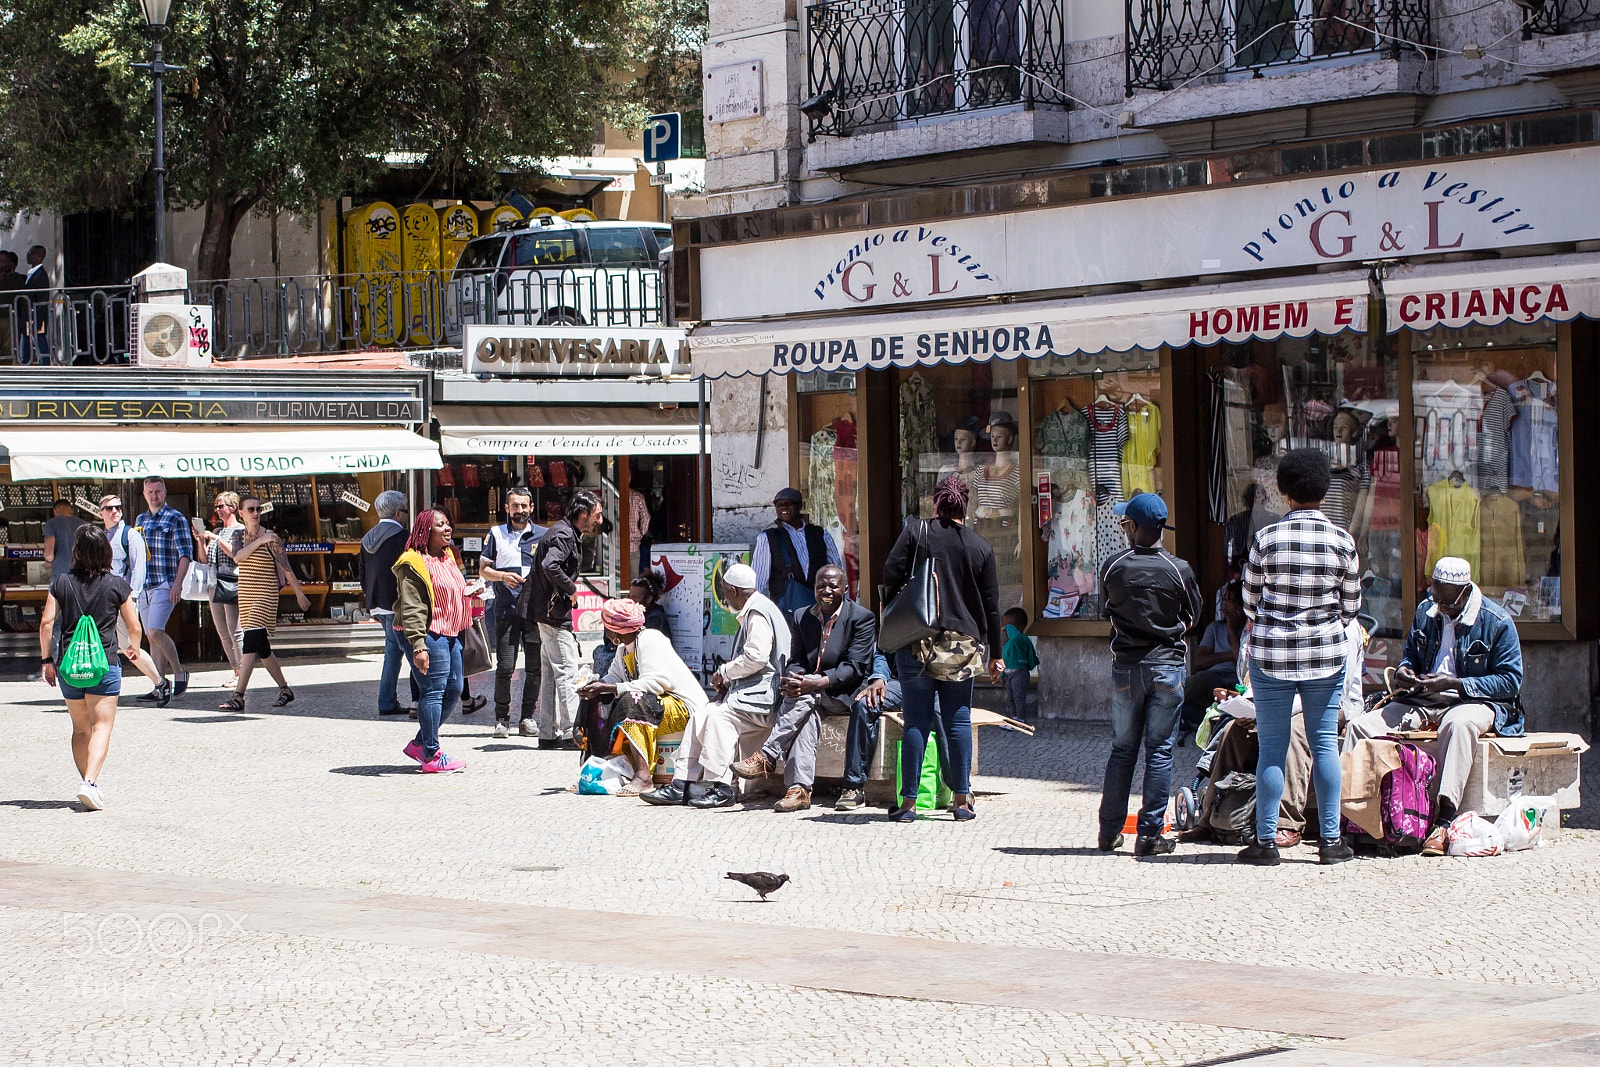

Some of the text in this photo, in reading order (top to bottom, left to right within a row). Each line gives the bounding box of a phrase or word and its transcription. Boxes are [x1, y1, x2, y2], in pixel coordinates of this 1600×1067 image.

[650, 119, 671, 159] P
[1377, 171, 1400, 189] a
[892, 229, 909, 243] a
[1309, 200, 1464, 258] G & L
[841, 253, 958, 302] G & L
[1399, 283, 1570, 322] CRIANÇA
[1188, 298, 1354, 338] HOMEM E
[476, 337, 670, 364] OURIVESARIA
[772, 339, 858, 367] ROUPA
[871, 336, 904, 361] DE
[916, 325, 1054, 358] SENHORA
[255, 402, 369, 418] PLURIMETAL
[376, 402, 412, 417] LDA
[466, 434, 690, 450] Compra e Venda de Usados
[65, 454, 393, 474] COMPRA OURO USADO VENDA
[577, 595, 604, 610] RATA
